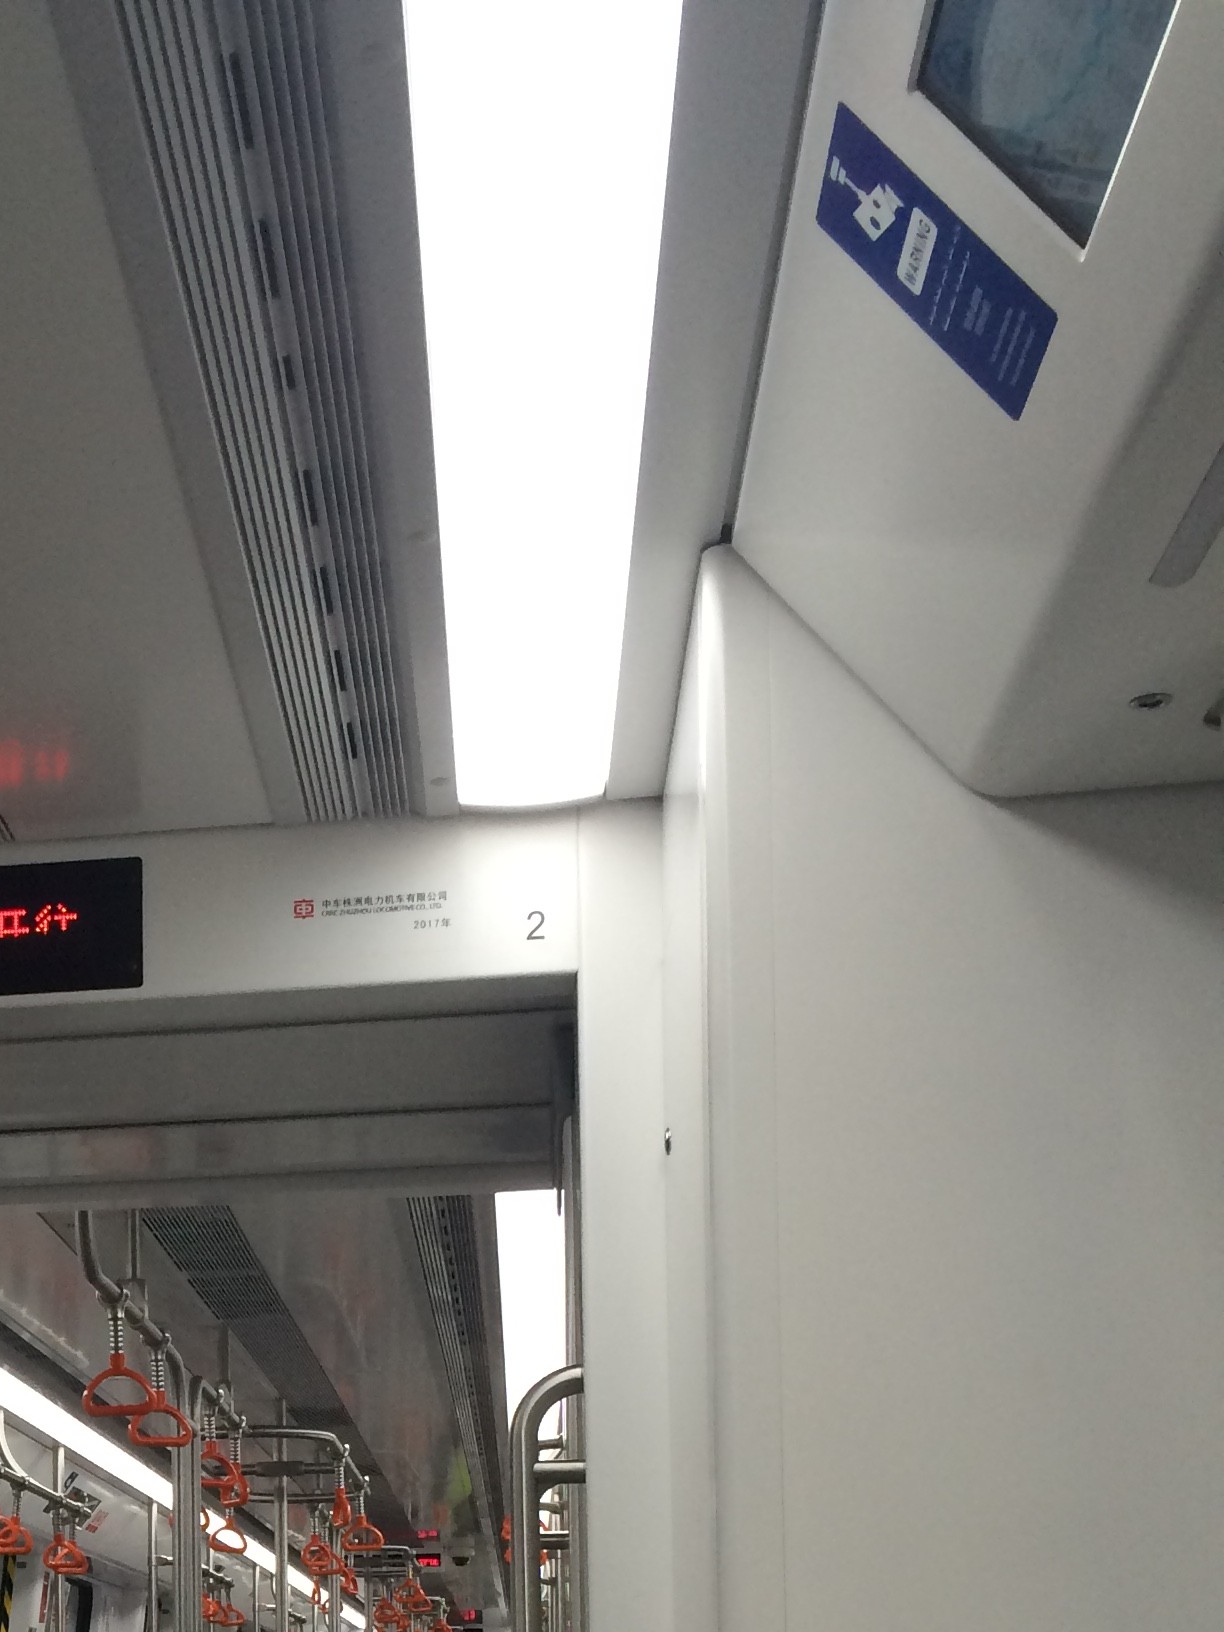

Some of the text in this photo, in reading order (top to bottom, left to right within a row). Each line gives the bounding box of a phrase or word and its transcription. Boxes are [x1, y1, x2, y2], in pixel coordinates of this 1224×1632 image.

[903, 217, 932, 288] WARNING
[413, 917, 451, 930] 2017年
[526, 910, 546, 941] 2
